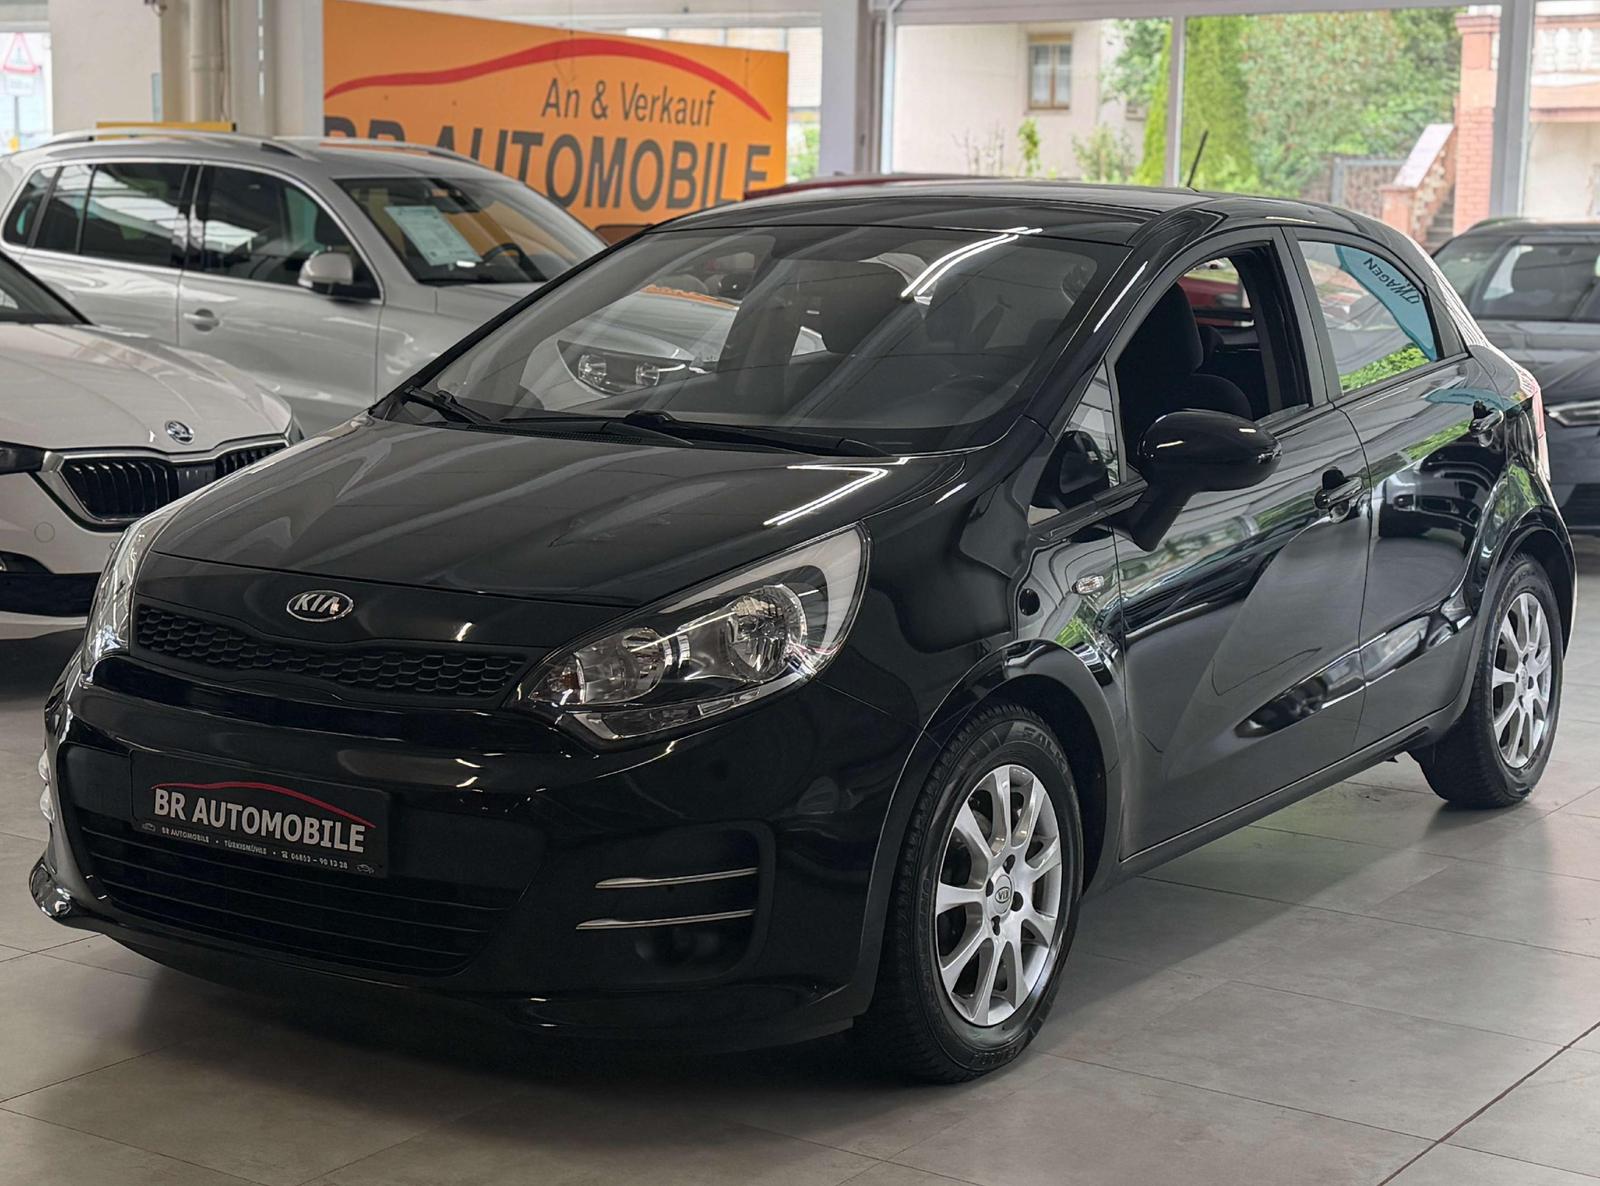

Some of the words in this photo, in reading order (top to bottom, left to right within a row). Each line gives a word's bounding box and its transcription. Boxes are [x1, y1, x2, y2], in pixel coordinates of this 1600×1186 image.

[541, 77, 580, 118] An
[591, 80, 609, 120] &
[620, 81, 716, 127] Verkauf
[293, 593, 341, 615] KIA
[154, 788, 186, 821] BR
[192, 797, 366, 853] AUTOMOBILE
[170, 829, 210, 843] AUTOMOBILE
